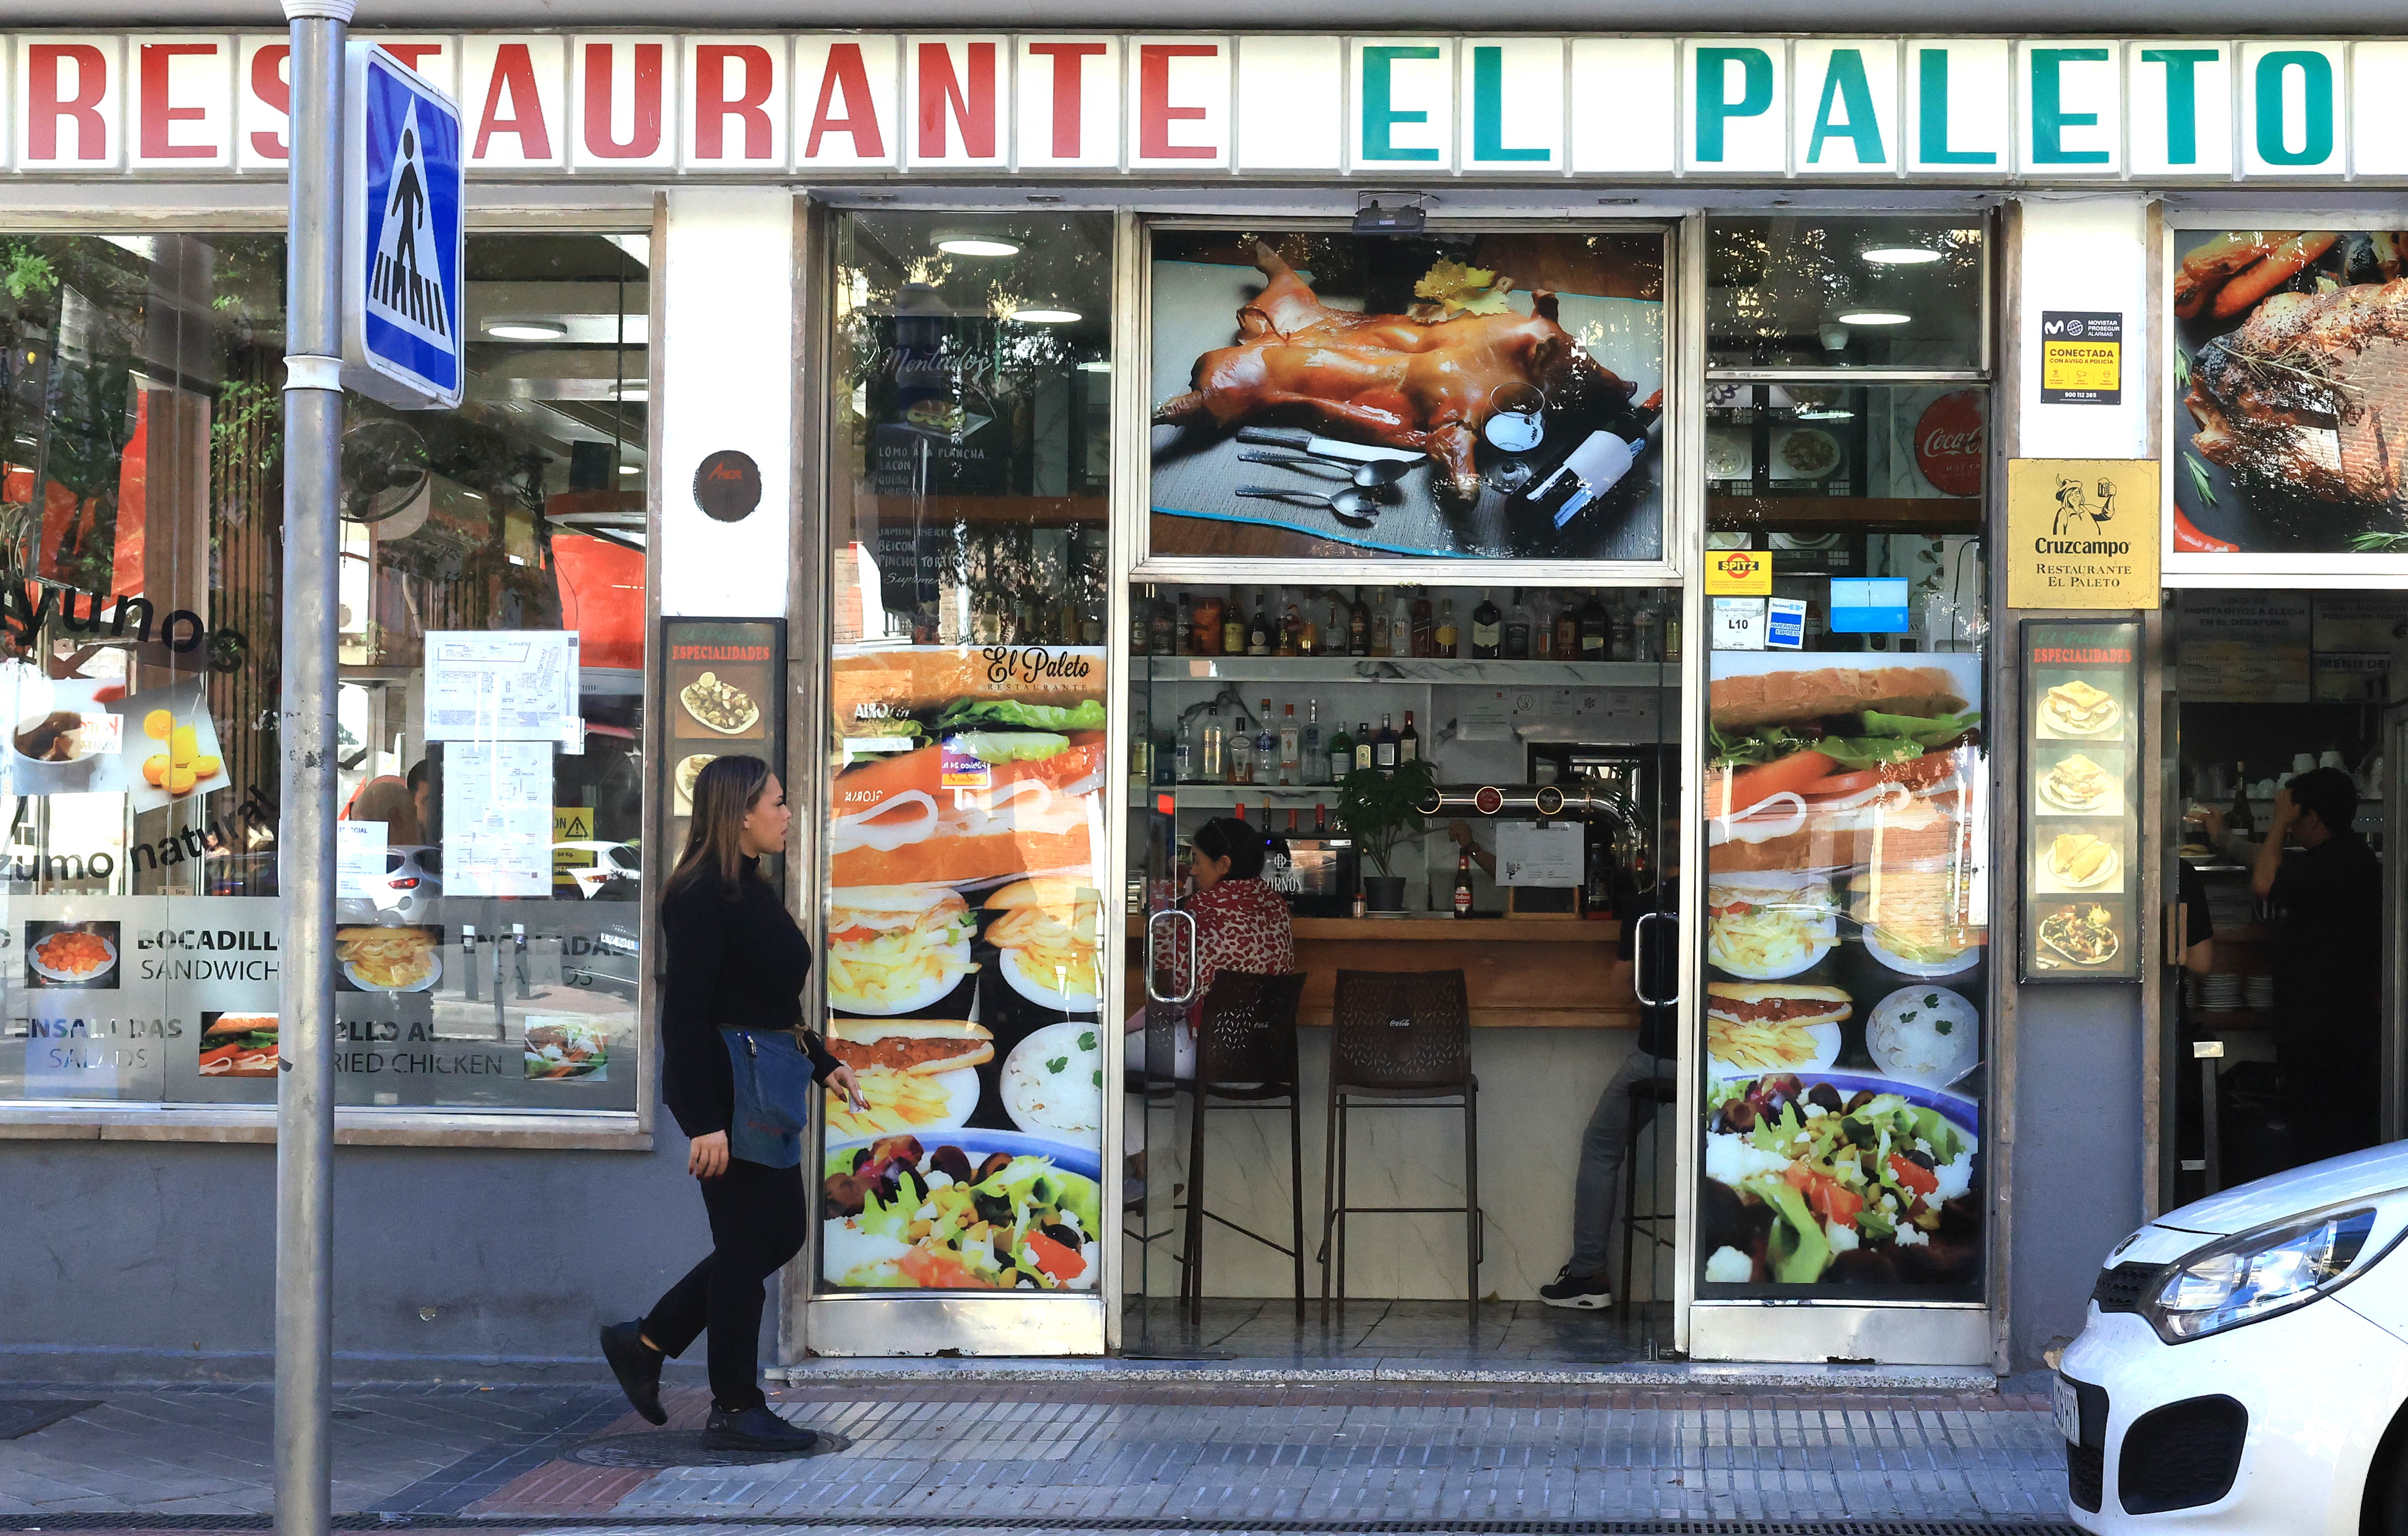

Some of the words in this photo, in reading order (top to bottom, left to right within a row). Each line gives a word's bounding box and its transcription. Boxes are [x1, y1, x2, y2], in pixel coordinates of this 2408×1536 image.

[1362, 46, 1551, 161] EL
[1696, 47, 2333, 165] PALETO
[2050, 349, 2113, 357] CONECTADA
[1924, 426, 1982, 458] Coca-C
[879, 446, 908, 457] LOMO
[878, 541, 916, 552] BEICON
[2035, 537, 2130, 557] Cruzcampo
[878, 555, 916, 567] PINCHO
[1721, 561, 1756, 571] SPITZ
[2036, 563, 2132, 574] RESTAURANTE
[2048, 577, 2065, 587] EL
[2070, 577, 2120, 588] PALETO
[2183, 607, 2256, 615] MONTADITOS
[1728, 619, 1748, 629] L10
[672, 646, 770, 661] ESPECIALIDADES
[2034, 648, 2132, 663] ESPECIALIDADES
[983, 646, 1017, 684] El
[1023, 647, 1091, 684] Paleto
[987, 684, 1088, 692] RESTAURANTE
[130, 784, 278, 873] natural
[1264, 876, 1302, 893] ORNOS
[137, 930, 279, 951] BOCADILL
[333, 1052, 383, 1074] RIED
[390, 1053, 501, 1075] CHICKEN
